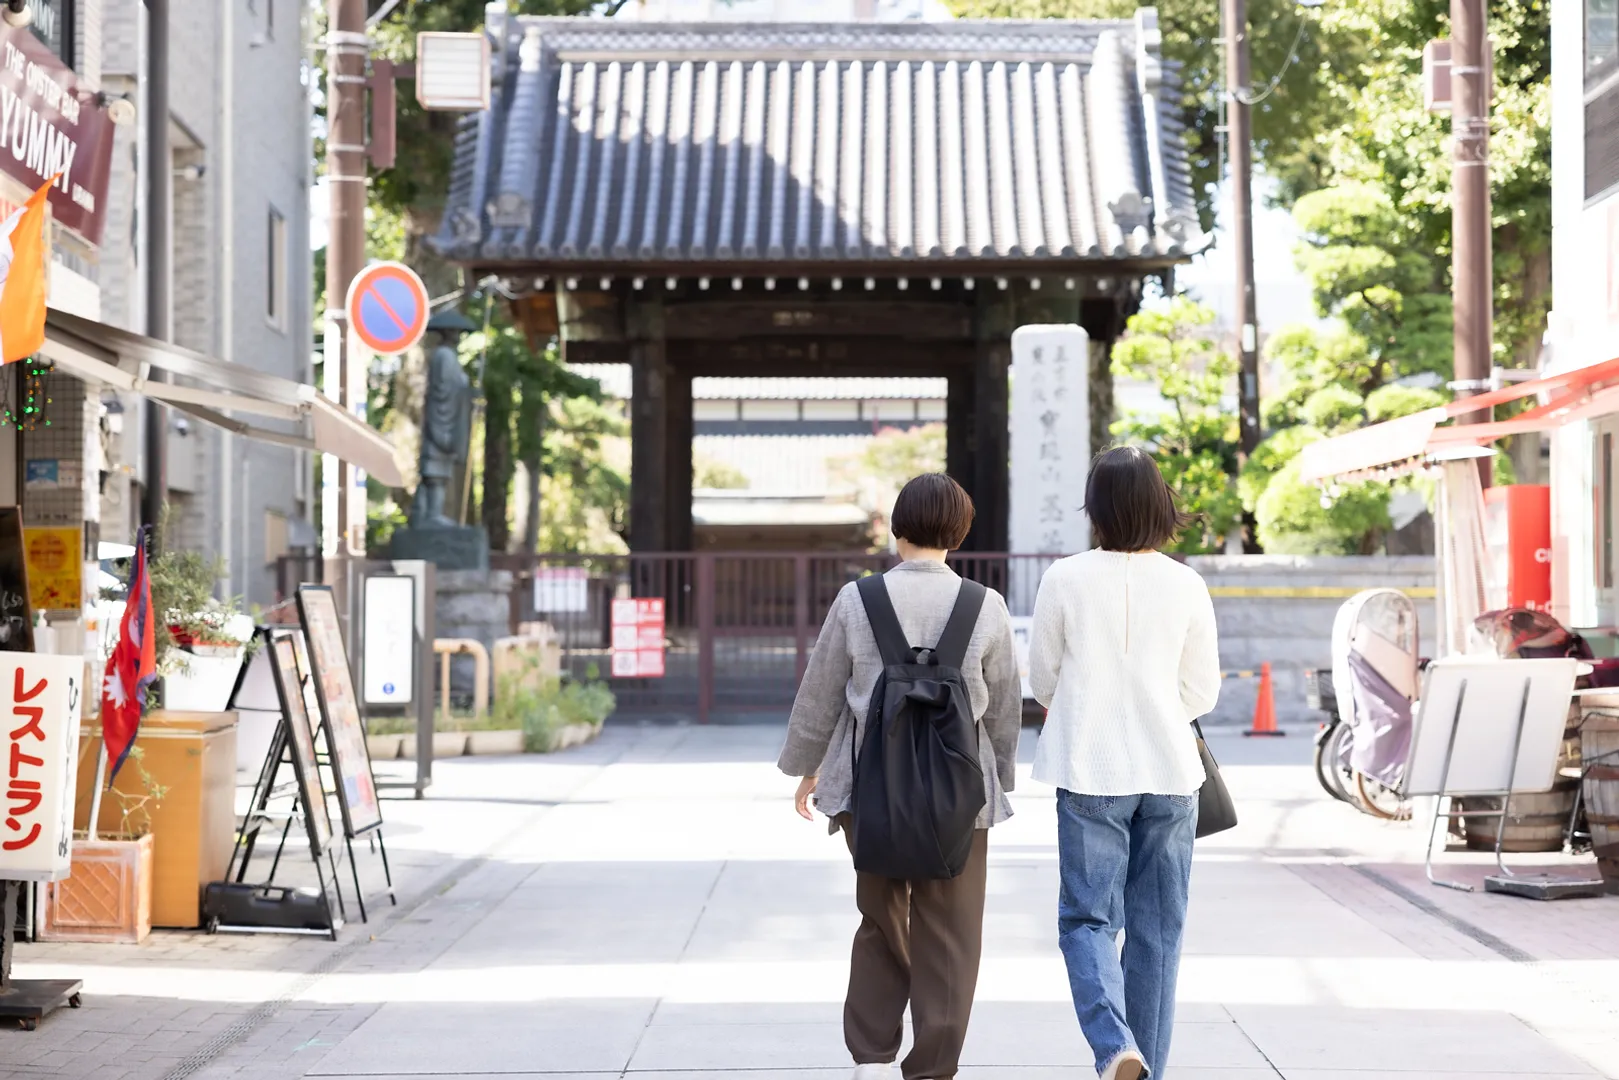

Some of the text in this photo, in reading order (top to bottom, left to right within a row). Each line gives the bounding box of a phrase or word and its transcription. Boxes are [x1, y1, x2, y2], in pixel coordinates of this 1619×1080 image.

[5, 41, 26, 80] THE
[26, 61, 61, 110] OYSTER
[0, 84, 77, 193] YUMMY
[2, 667, 49, 851] レストラン
